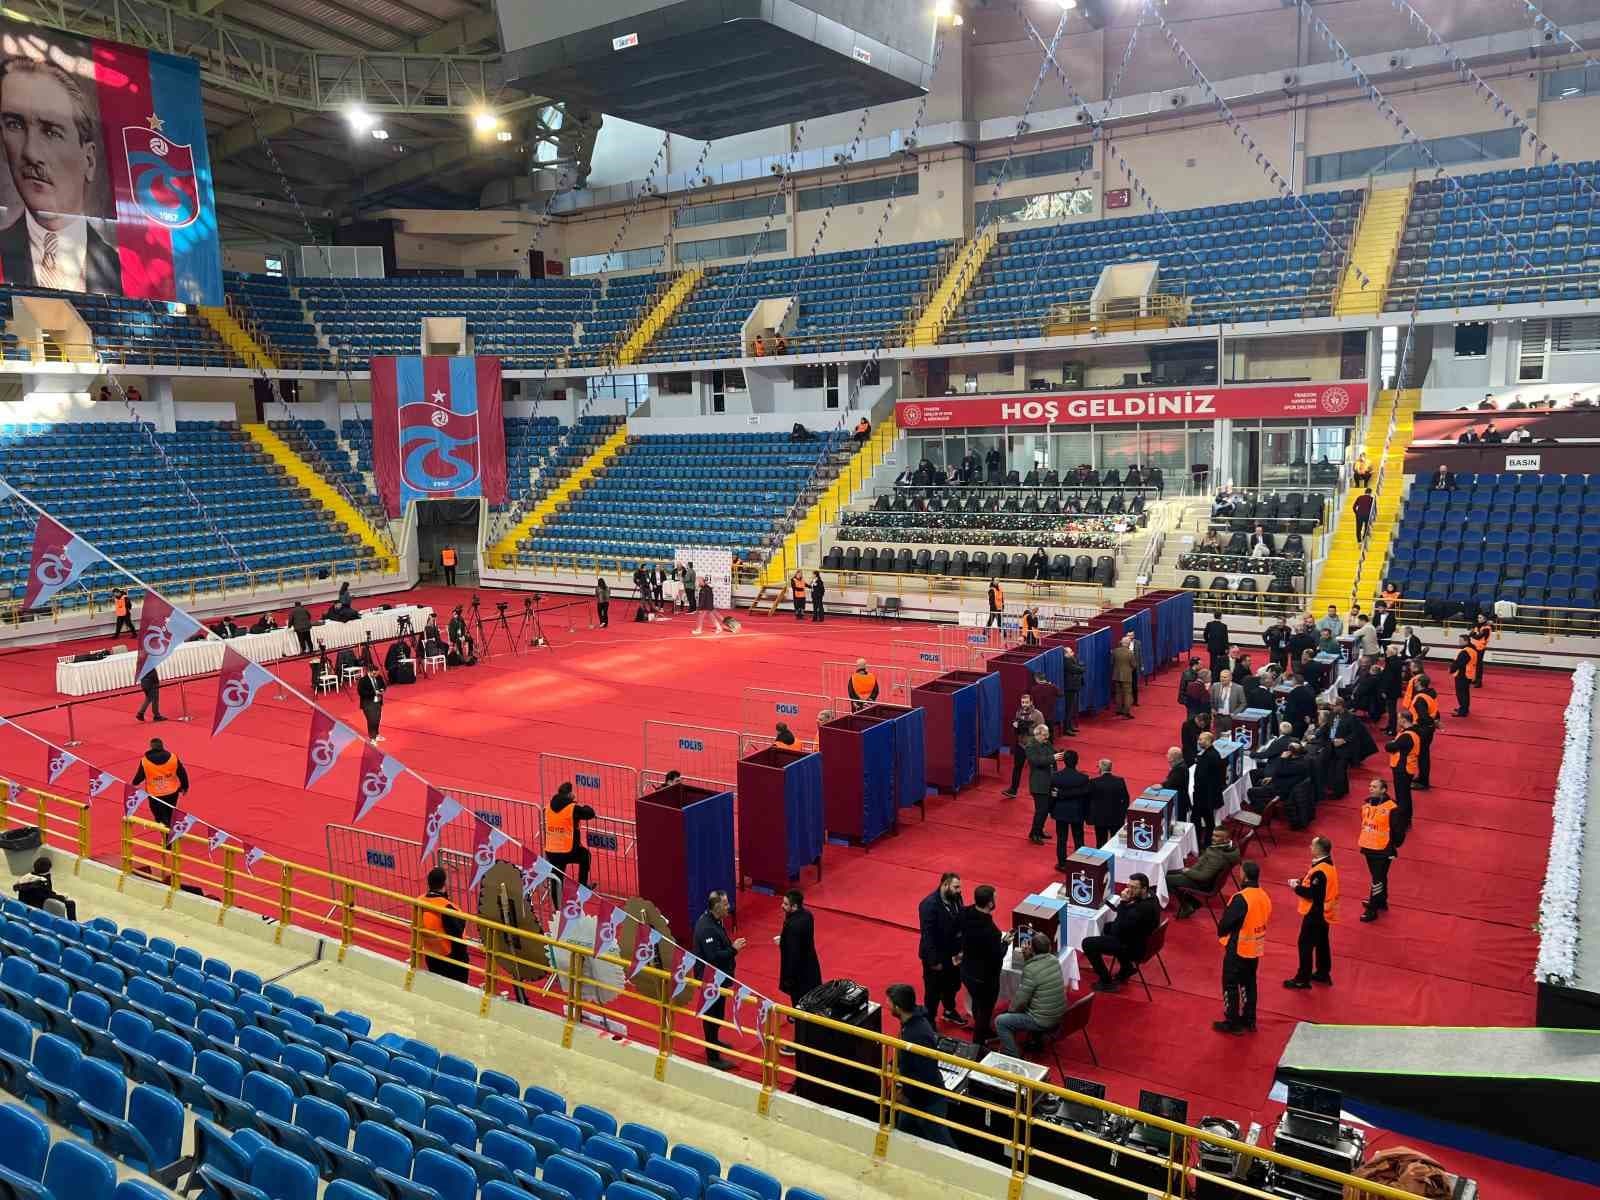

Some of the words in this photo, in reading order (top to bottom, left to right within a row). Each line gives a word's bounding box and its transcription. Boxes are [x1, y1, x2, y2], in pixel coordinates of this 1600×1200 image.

[1001, 400, 1059, 424] HOŞ
[1067, 392, 1216, 417] GELDİNİZ
[1509, 458, 1537, 467] BASIN
